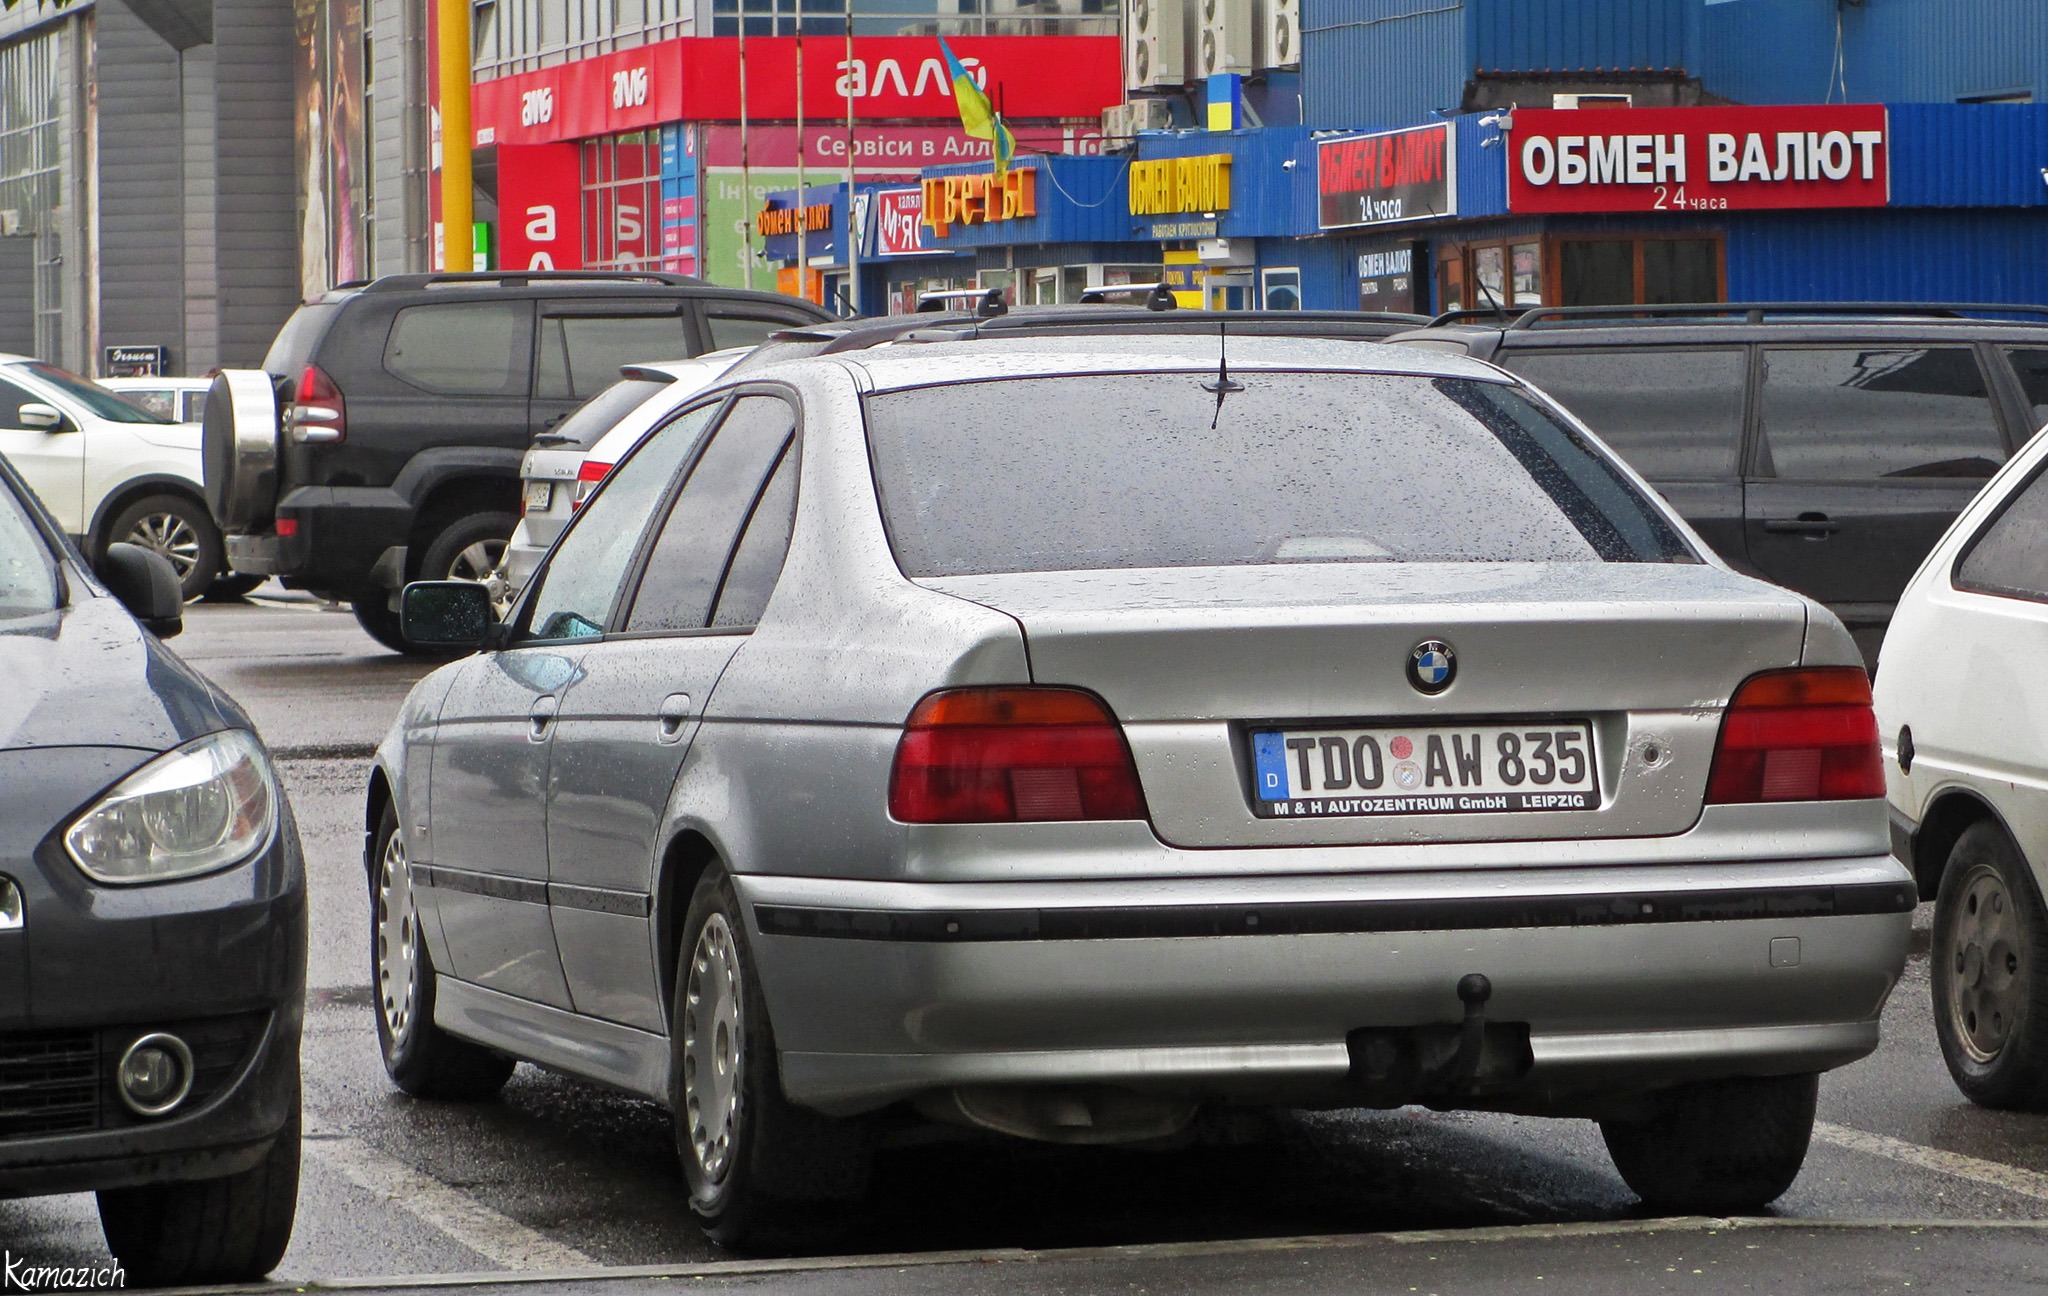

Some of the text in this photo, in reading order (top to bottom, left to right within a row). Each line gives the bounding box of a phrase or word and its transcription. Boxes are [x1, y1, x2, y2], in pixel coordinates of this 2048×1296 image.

[922, 141, 935, 156] в
[943, 136, 994, 156] Алл
[1521, 130, 1882, 186] ОБМЕН ВАЛЮТ
[1319, 127, 1446, 195] ОБМЕН ВАЛЮТ
[1129, 154, 1232, 216] ОБМЕН ВАЛЮТ
[1653, 185, 1728, 210] 24 часа
[921, 166, 1037, 238] Цветы
[1360, 196, 1402, 221] 24 часа
[1358, 249, 1412, 278] ОБМЕН ВАЛЮТ
[1413, 642, 1454, 660] BMW
[1286, 732, 1586, 790] TDO AW 835
[1266, 773, 1278, 788] D
[1274, 795, 1585, 815] M & H AUTOZENTRUM GmbH LEIPZIG
